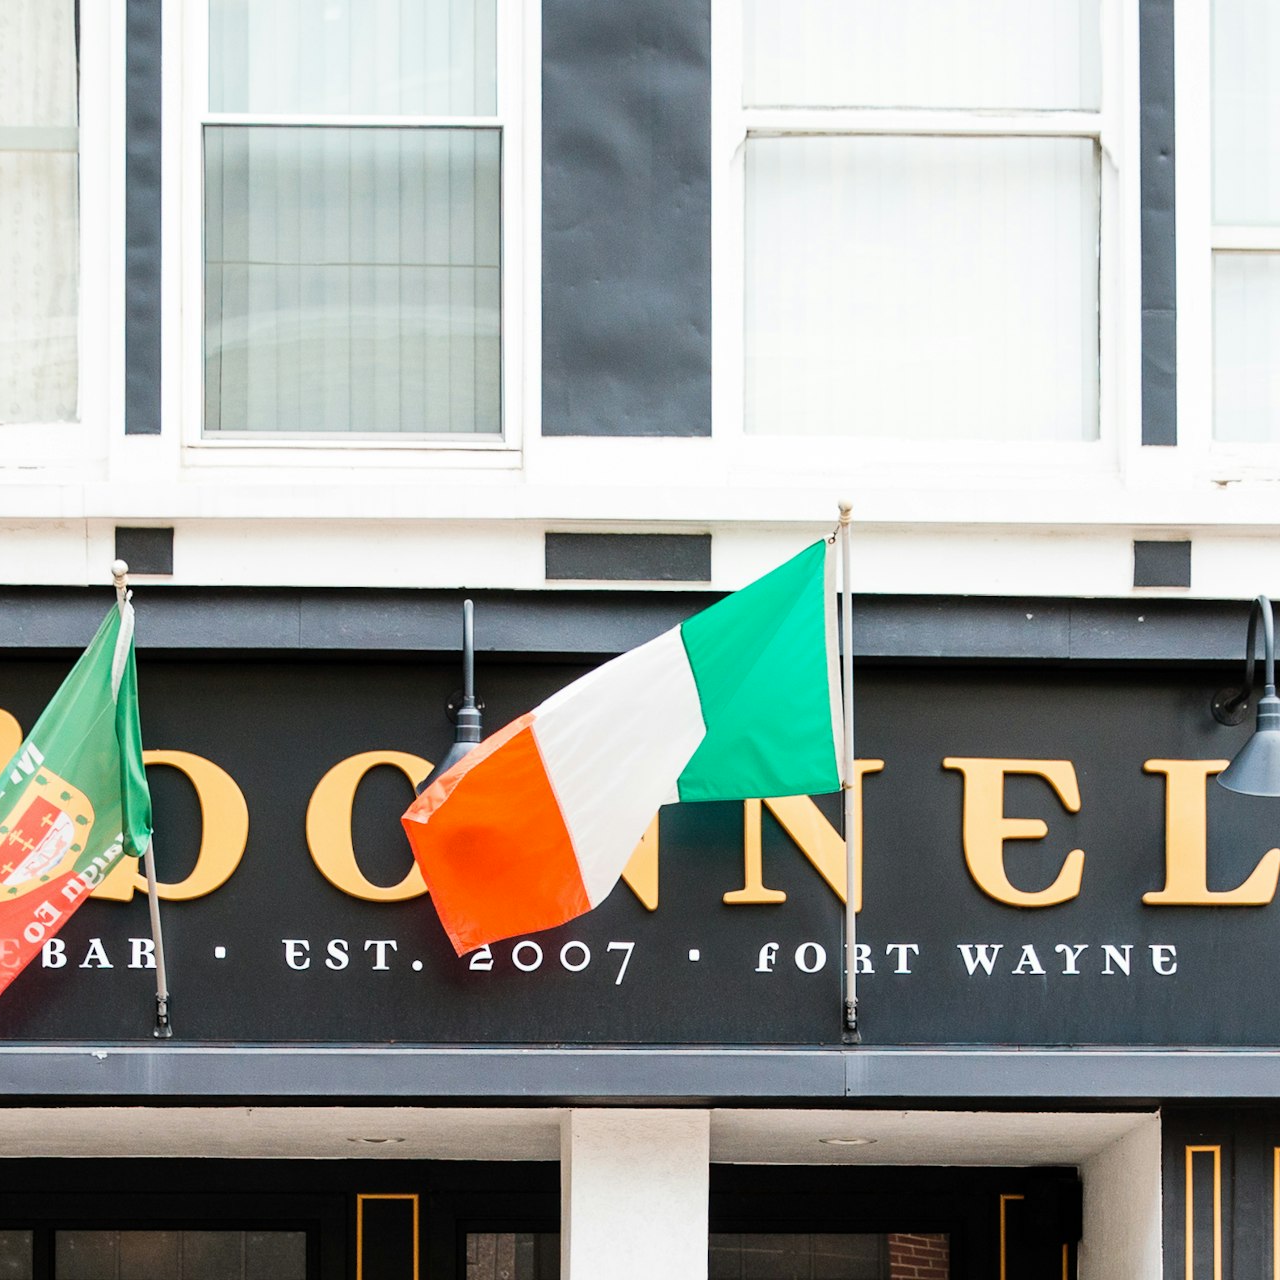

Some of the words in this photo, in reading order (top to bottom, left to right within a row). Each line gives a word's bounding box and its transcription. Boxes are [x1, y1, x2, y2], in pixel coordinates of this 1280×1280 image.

[282, 939, 424, 972] EST.
[468, 940, 637, 985] 2007
[755, 942, 921, 975] FORT
[957, 943, 1179, 976] WAYNE
